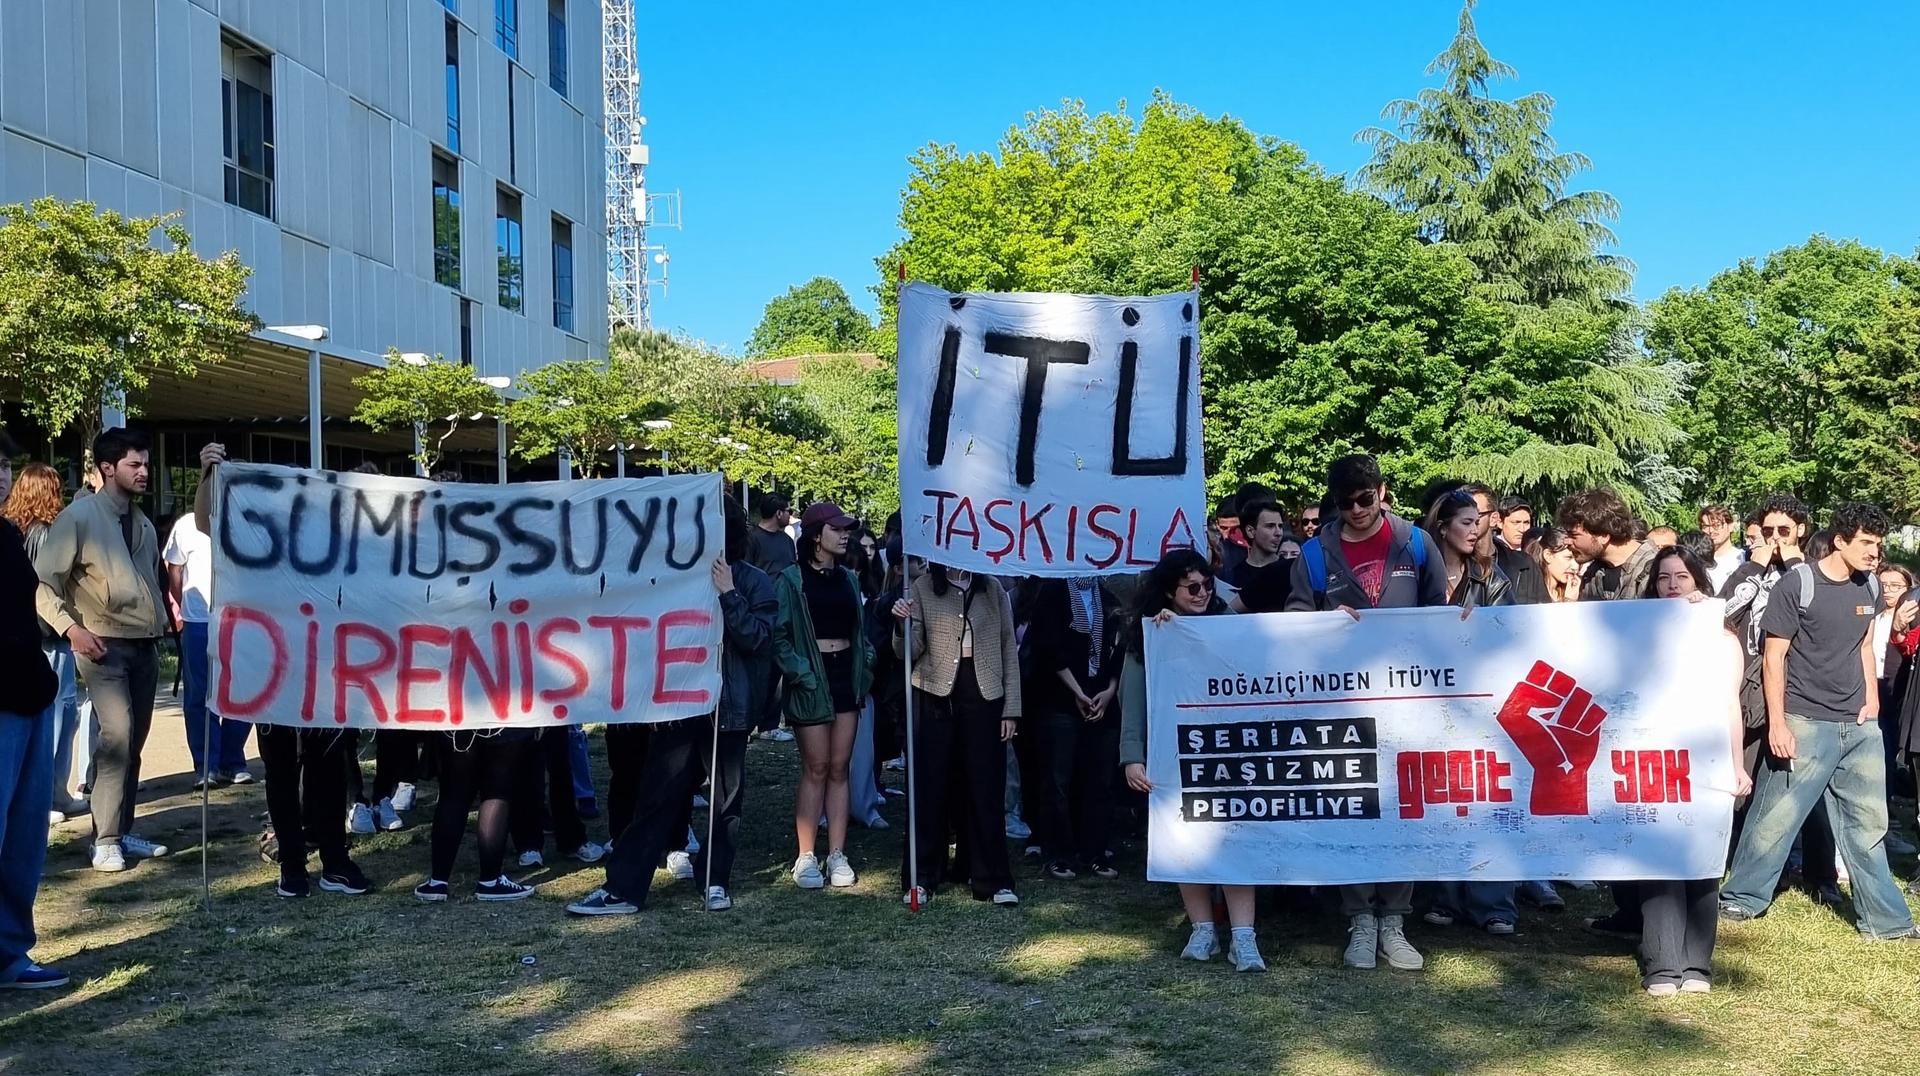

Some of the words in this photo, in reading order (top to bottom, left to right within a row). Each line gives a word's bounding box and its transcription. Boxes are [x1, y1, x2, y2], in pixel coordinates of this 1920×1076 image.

[926, 297, 1194, 486] İTÜ
[219, 469, 706, 586] GÜMÜŞSUYU
[216, 599, 711, 725] DİRENİŞTE
[1207, 670, 1371, 698] BOĞAZİÇİ'NDEN
[1388, 665, 1456, 688] İTÜ'YE
[1188, 722, 1362, 753] ŞERİATA
[1190, 757, 1362, 785] FAŞİZME
[1192, 792, 1364, 818] PEDOFİLİYE
